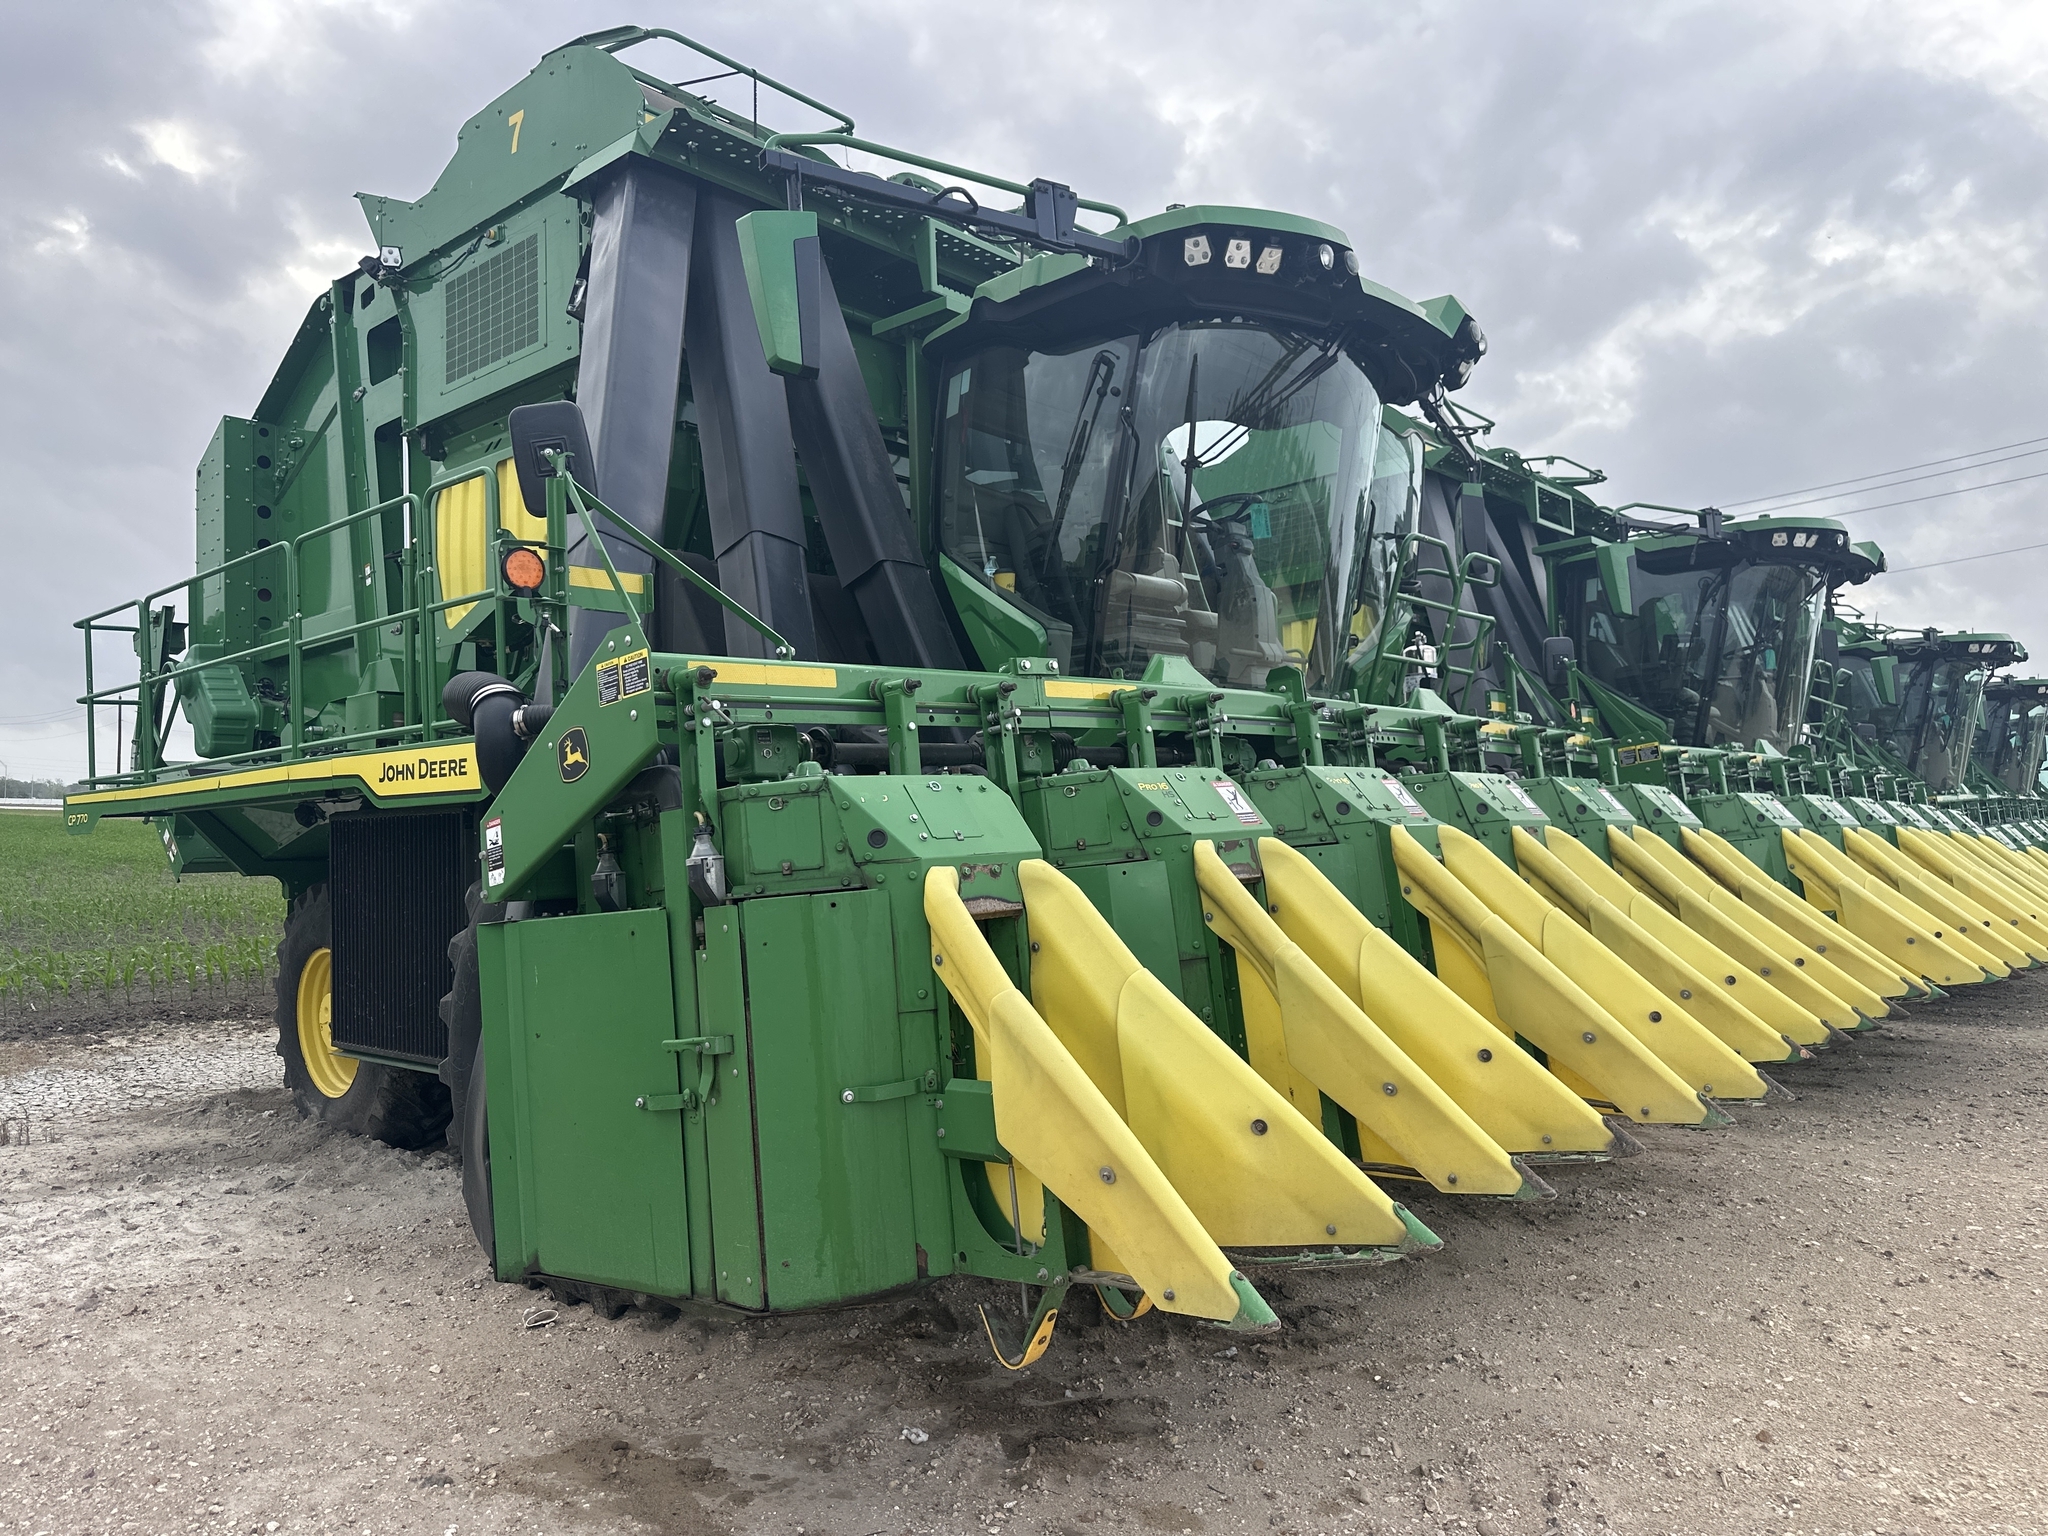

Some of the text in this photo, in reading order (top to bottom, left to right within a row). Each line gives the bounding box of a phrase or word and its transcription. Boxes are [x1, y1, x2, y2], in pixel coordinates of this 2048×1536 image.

[508, 109, 525, 154] 7
[379, 758, 468, 783] JOHN DEERE
[76, 813, 88, 826] 770
